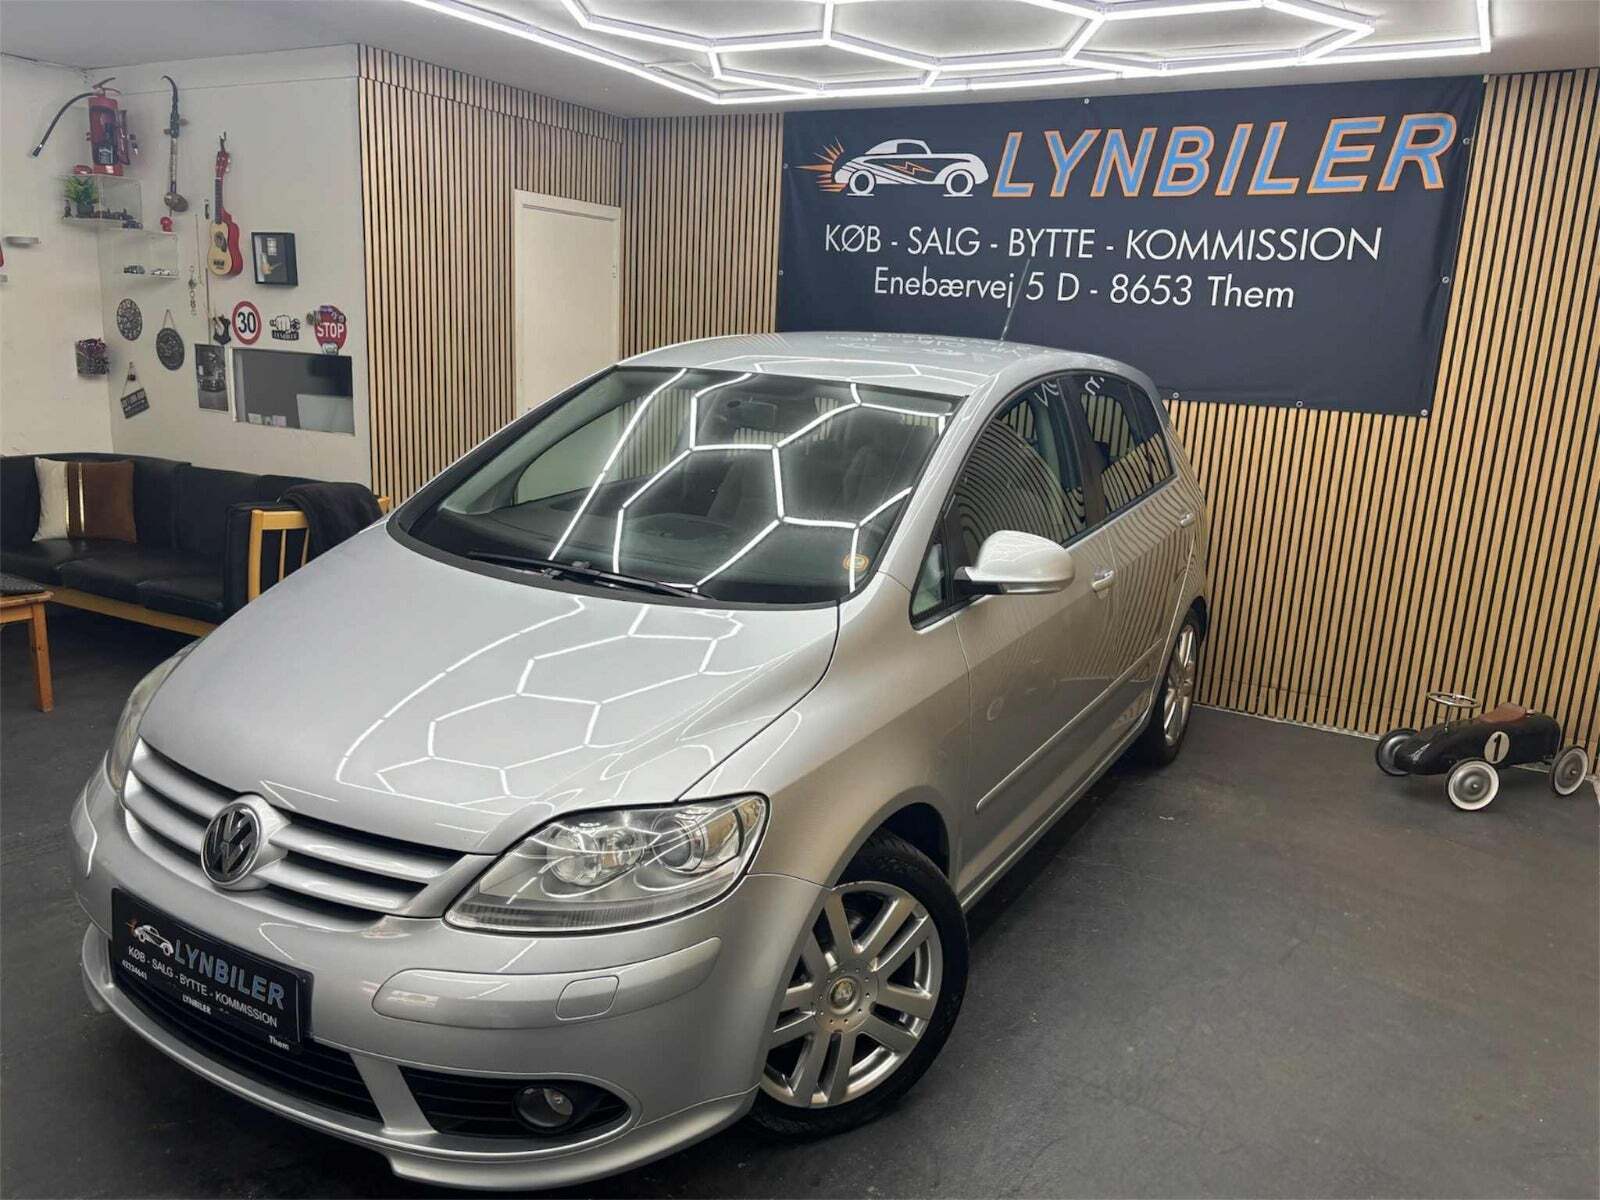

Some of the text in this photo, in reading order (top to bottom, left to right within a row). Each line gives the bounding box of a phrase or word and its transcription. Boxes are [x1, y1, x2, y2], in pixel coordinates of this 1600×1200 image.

[993, 112, 1458, 198] LYNBILER
[825, 224, 881, 253] KØB
[907, 226, 980, 256] SALG
[1008, 228, 1096, 258] BYTTE
[1125, 227, 1382, 261] KOMMISSION
[874, 266, 1015, 308] Enebærvej
[1025, 271, 1044, 301] 5
[1057, 272, 1080, 301] D
[1109, 273, 1193, 305] 8653
[1207, 273, 1295, 308] Them
[237, 311, 256, 334] 30
[317, 322, 345, 338] STOP
[1492, 734, 1502, 762] 1
[152, 958, 174, 978] SALG
[179, 973, 208, 996] BYTTE
[214, 990, 278, 1028] KOMMISSION
[174, 939, 285, 1011] LYNBILER
